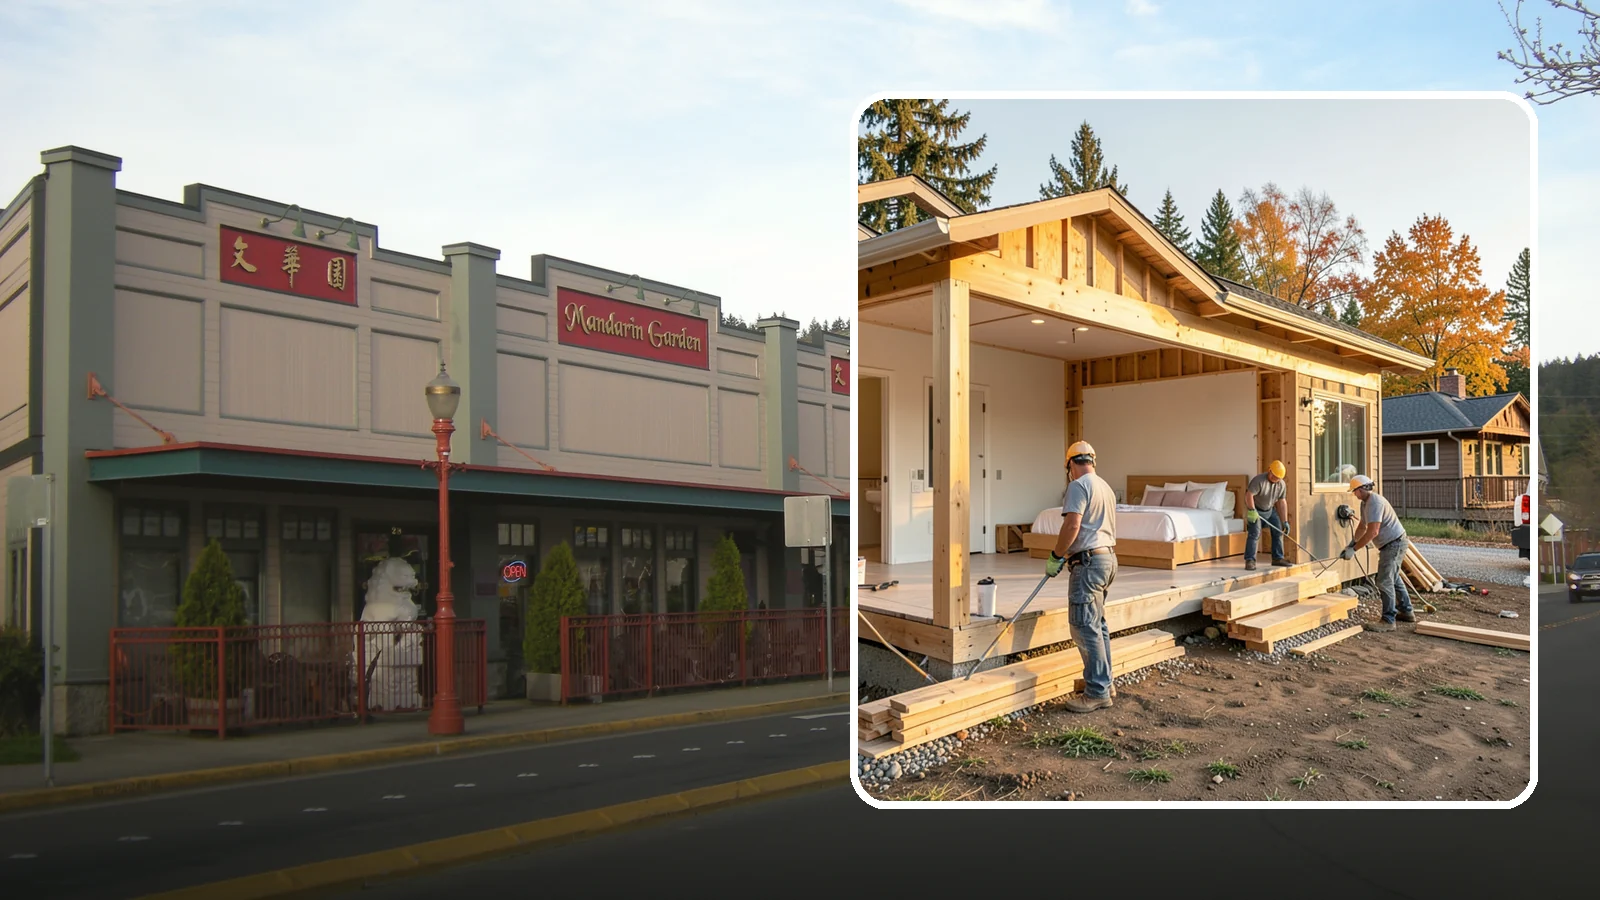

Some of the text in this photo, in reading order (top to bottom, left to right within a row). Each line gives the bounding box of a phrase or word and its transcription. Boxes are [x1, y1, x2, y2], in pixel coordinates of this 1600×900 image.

[231, 235, 346, 291] 文華園
[564, 302, 702, 352] Mandarin Garden
[834, 363, 847, 386] 文
[503, 564, 527, 578] OPEN
